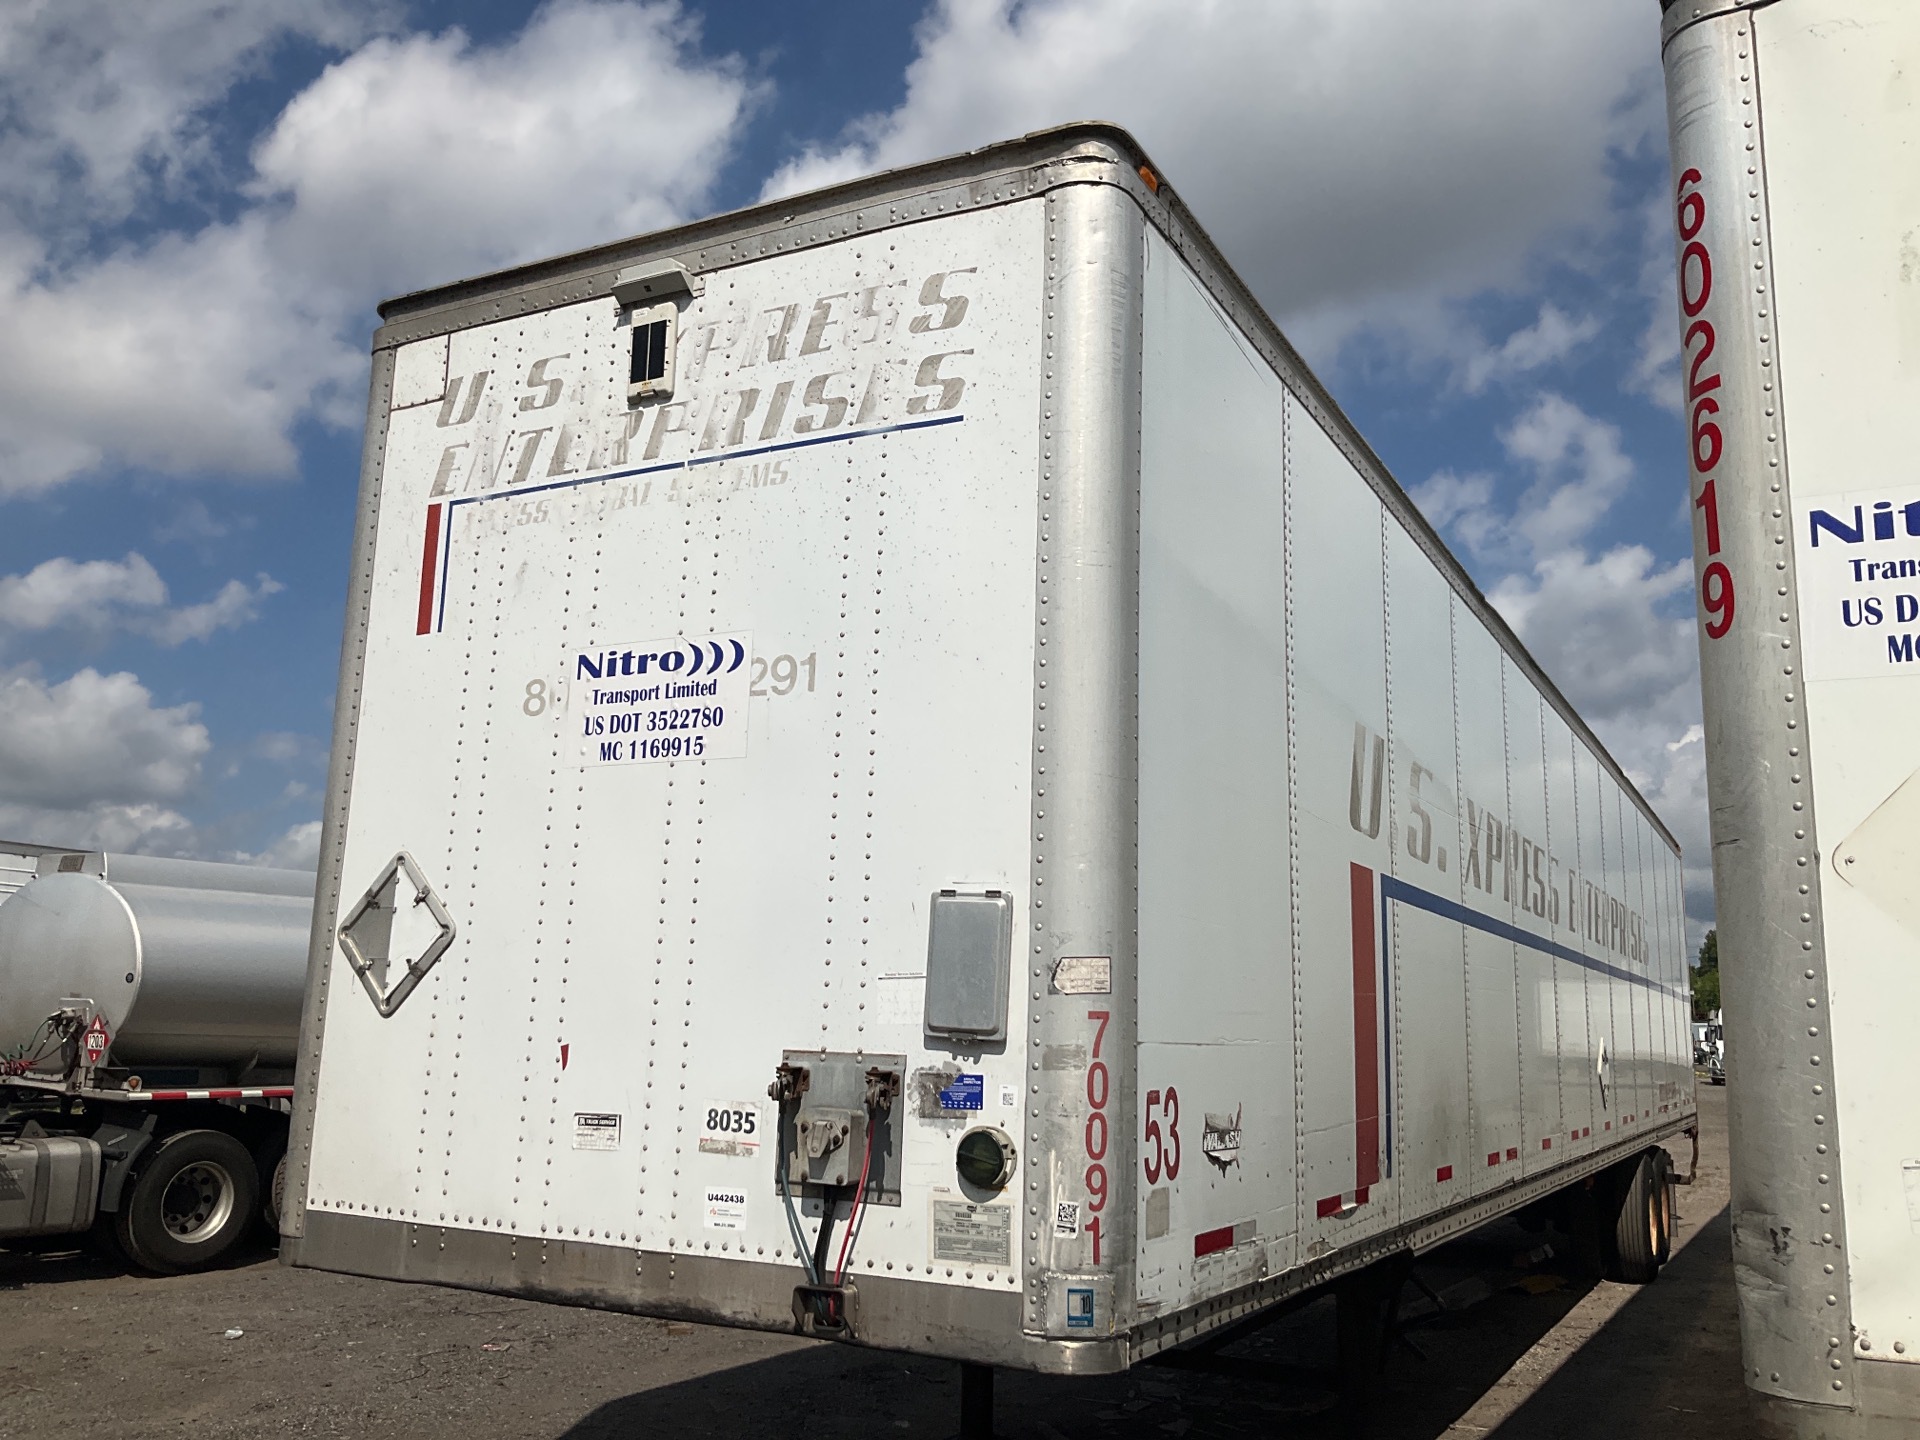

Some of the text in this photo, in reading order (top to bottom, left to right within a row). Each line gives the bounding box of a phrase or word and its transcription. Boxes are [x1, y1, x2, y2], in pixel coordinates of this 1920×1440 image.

[1677, 168, 1735, 639] 602619
[1848, 559, 1920, 582] Tran
[1842, 597, 1883, 627] US
[592, 679, 717, 706] Transport Limited
[584, 706, 724, 736] US DOT 3522780
[600, 736, 704, 762] MC 1169915
[89, 1034, 104, 1049] 1203
[706, 1108, 755, 1135] 8035
[1085, 1010, 1110, 1266] 70091
[1144, 1086, 1180, 1185] 53
[708, 1193, 745, 1204] U442438
